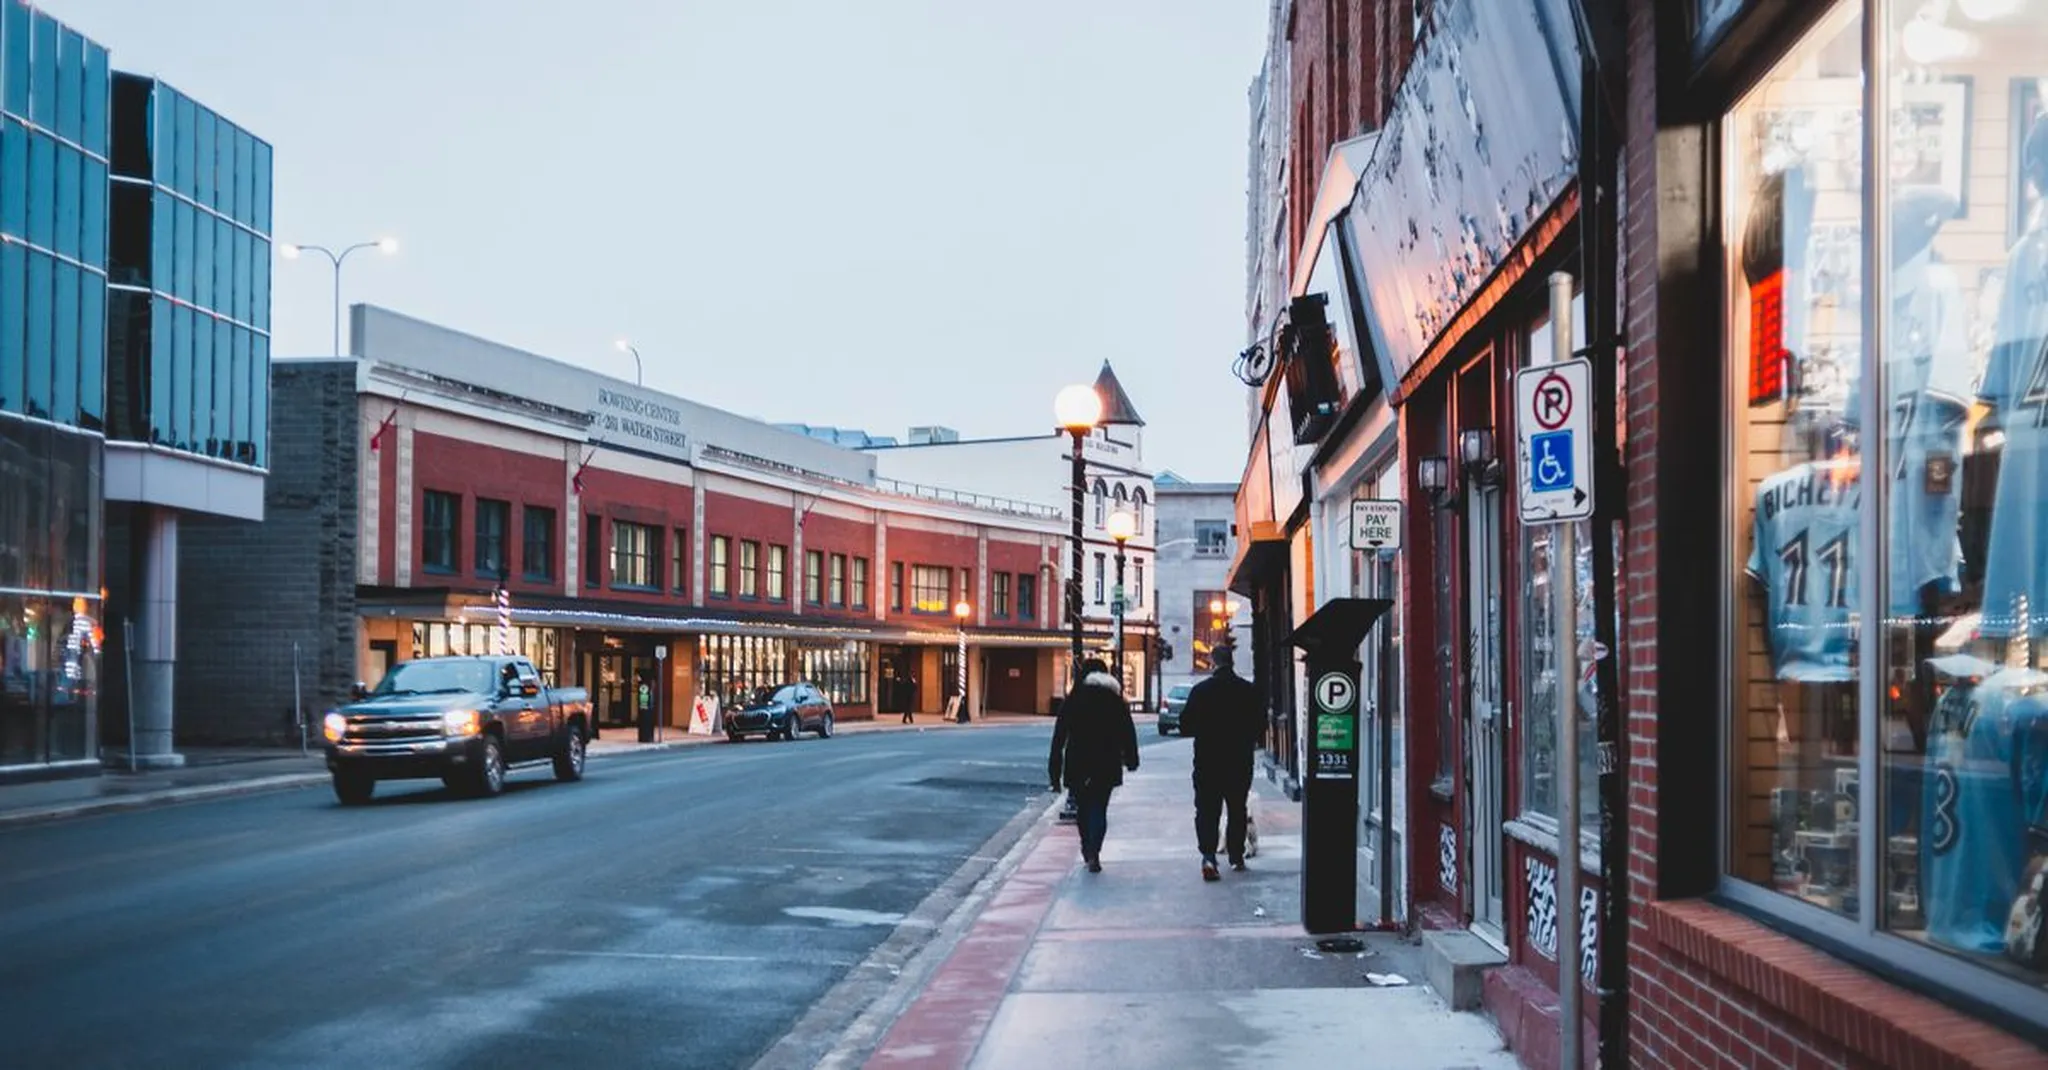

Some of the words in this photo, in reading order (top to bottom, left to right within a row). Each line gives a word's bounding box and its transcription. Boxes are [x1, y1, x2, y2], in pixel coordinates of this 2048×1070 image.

[598, 389, 644, 415] BOWRING
[644, 402, 681, 425] CENTRE
[621, 420, 653, 441] WATER
[653, 427, 686, 447] STREET
[1370, 504, 1398, 512] STATION
[1366, 514, 1387, 525] PAY
[1360, 527, 1392, 539] HERE
[1775, 527, 1849, 608] 11
[1328, 681, 1346, 705] P
[1319, 754, 1348, 764] 1331
